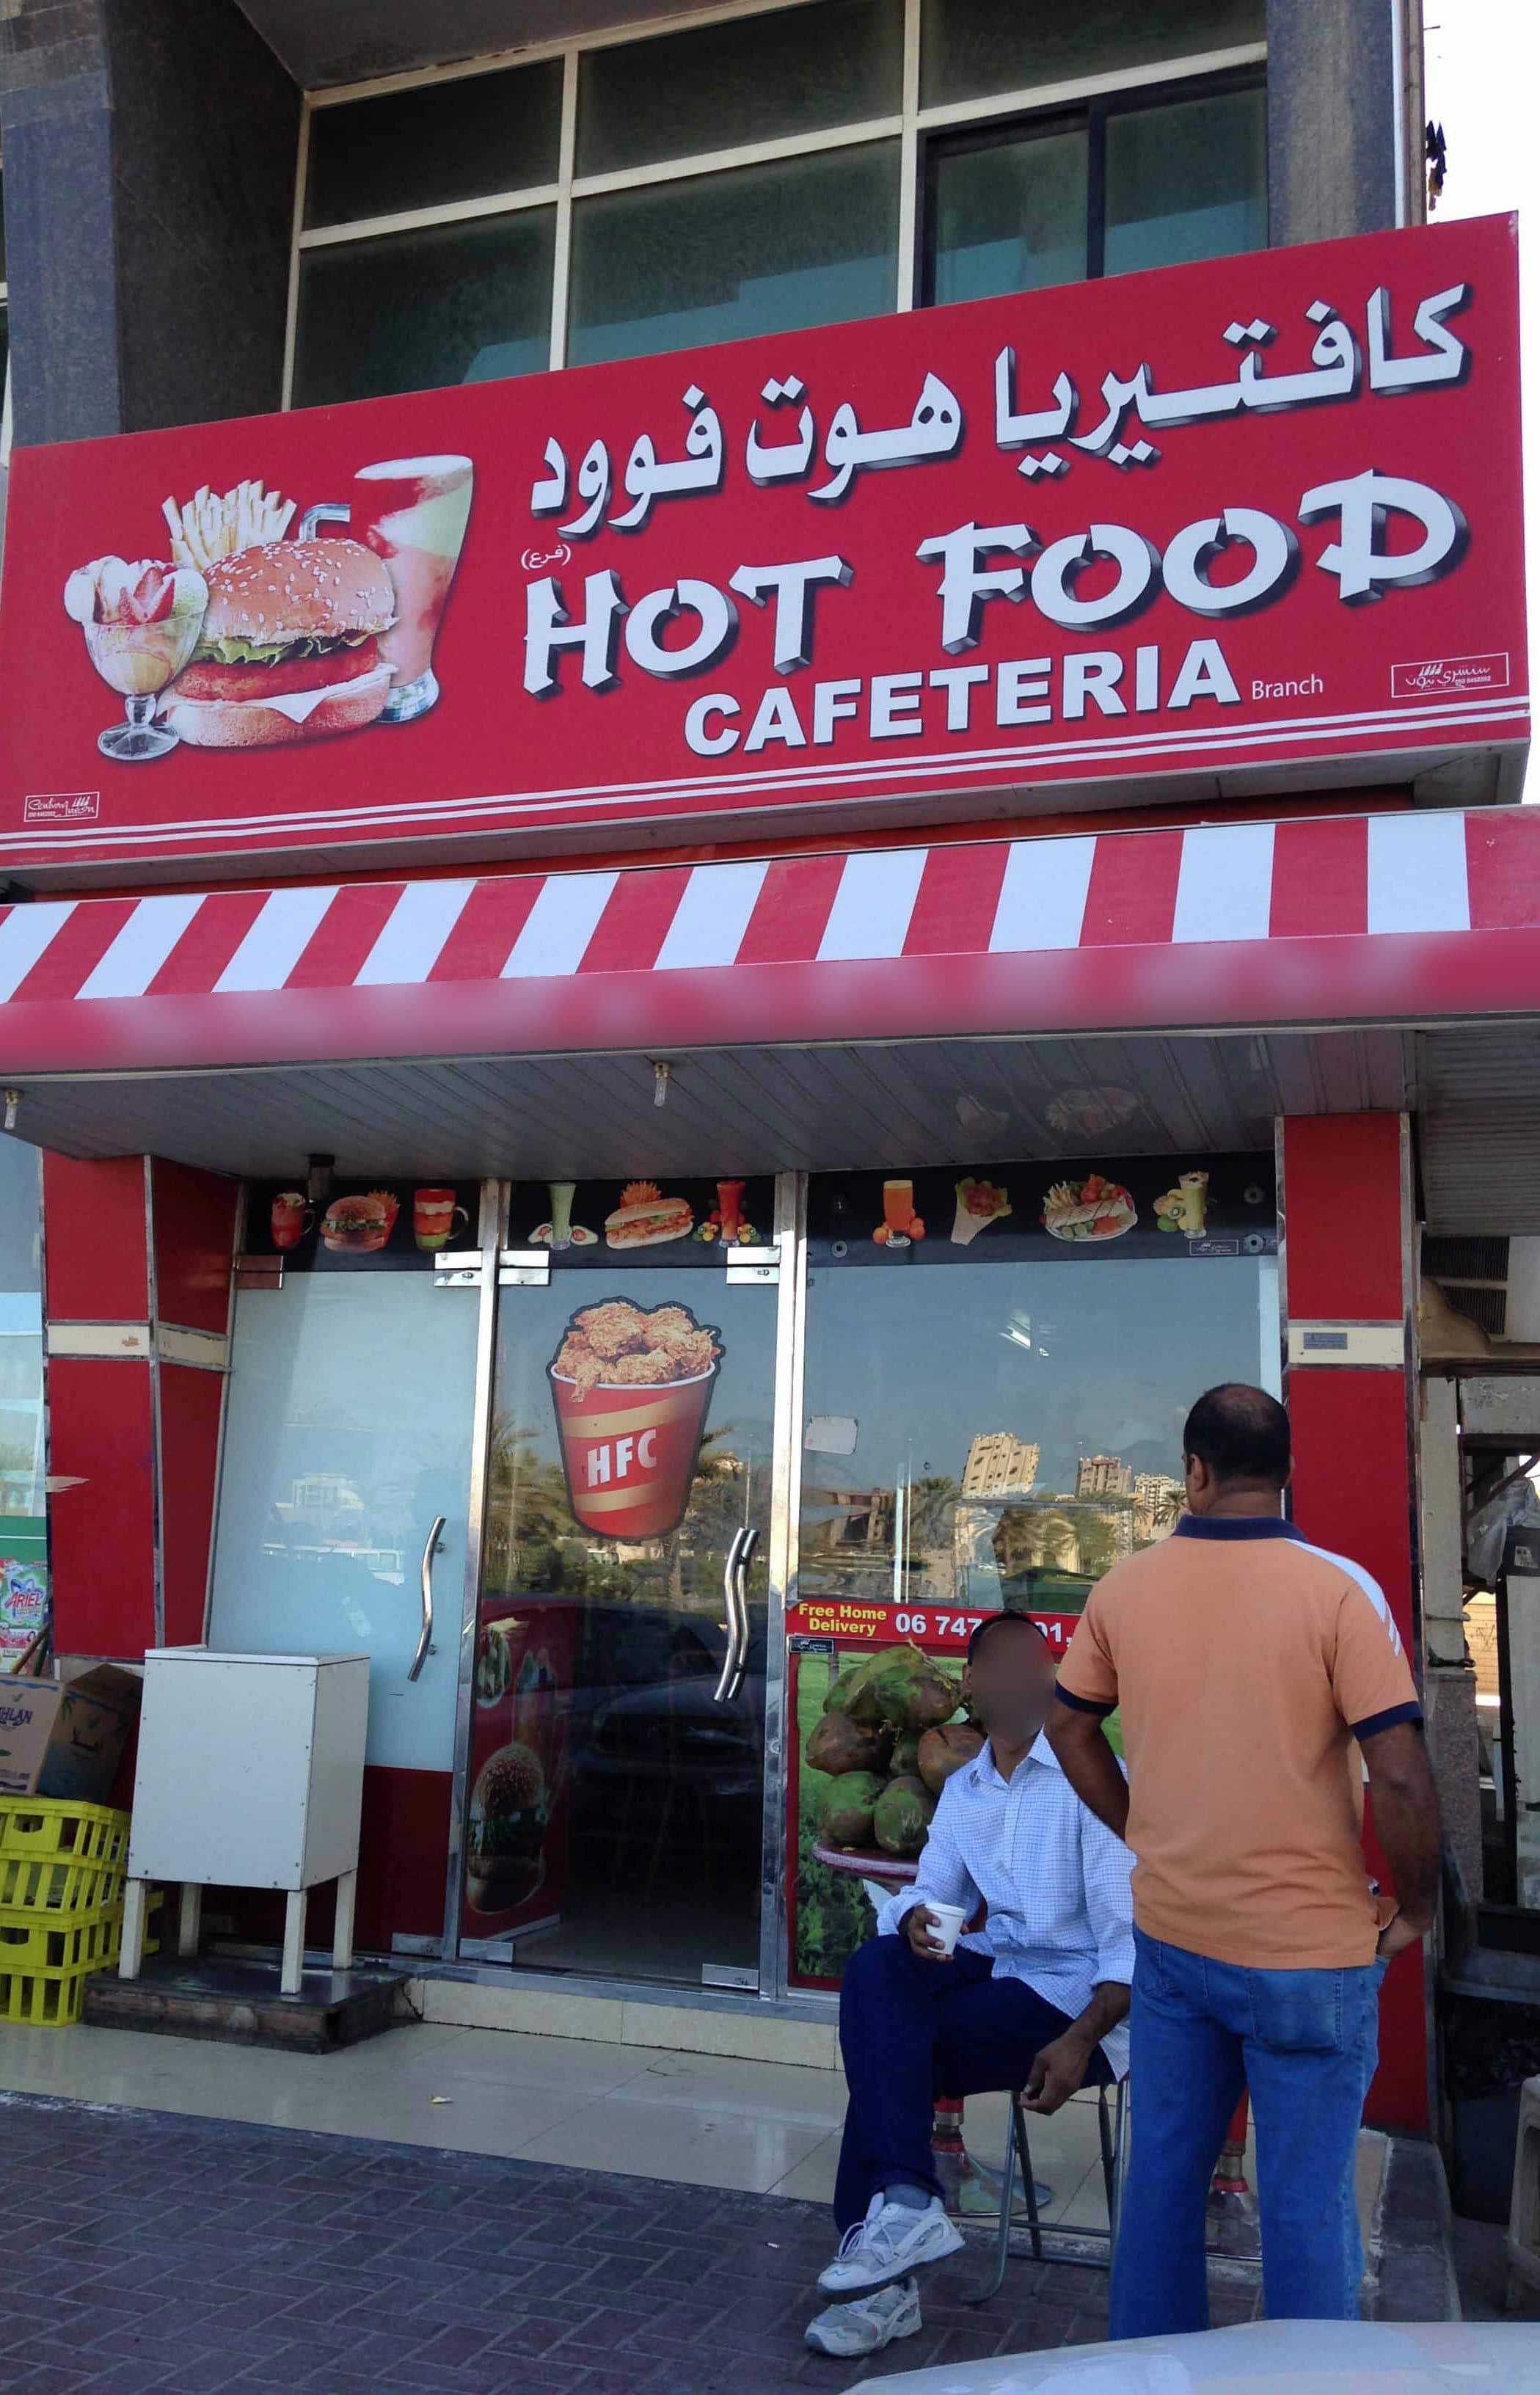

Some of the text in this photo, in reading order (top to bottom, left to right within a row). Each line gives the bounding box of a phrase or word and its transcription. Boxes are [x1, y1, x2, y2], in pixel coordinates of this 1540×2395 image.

[530, 283, 1467, 537] كافتيريا هوت فوود
[521, 544, 572, 570] (فرع)
[522, 469, 1464, 696] HOT FOOD
[684, 638, 1242, 756] CAFETERIA
[1252, 674, 1324, 700] Branch
[587, 1428, 657, 1487] HFC
[5, 1591, 42, 1609] ARIEL
[798, 1603, 887, 1621] Free Home
[809, 1617, 877, 1637] Delivery
[895, 1613, 927, 1634] 06
